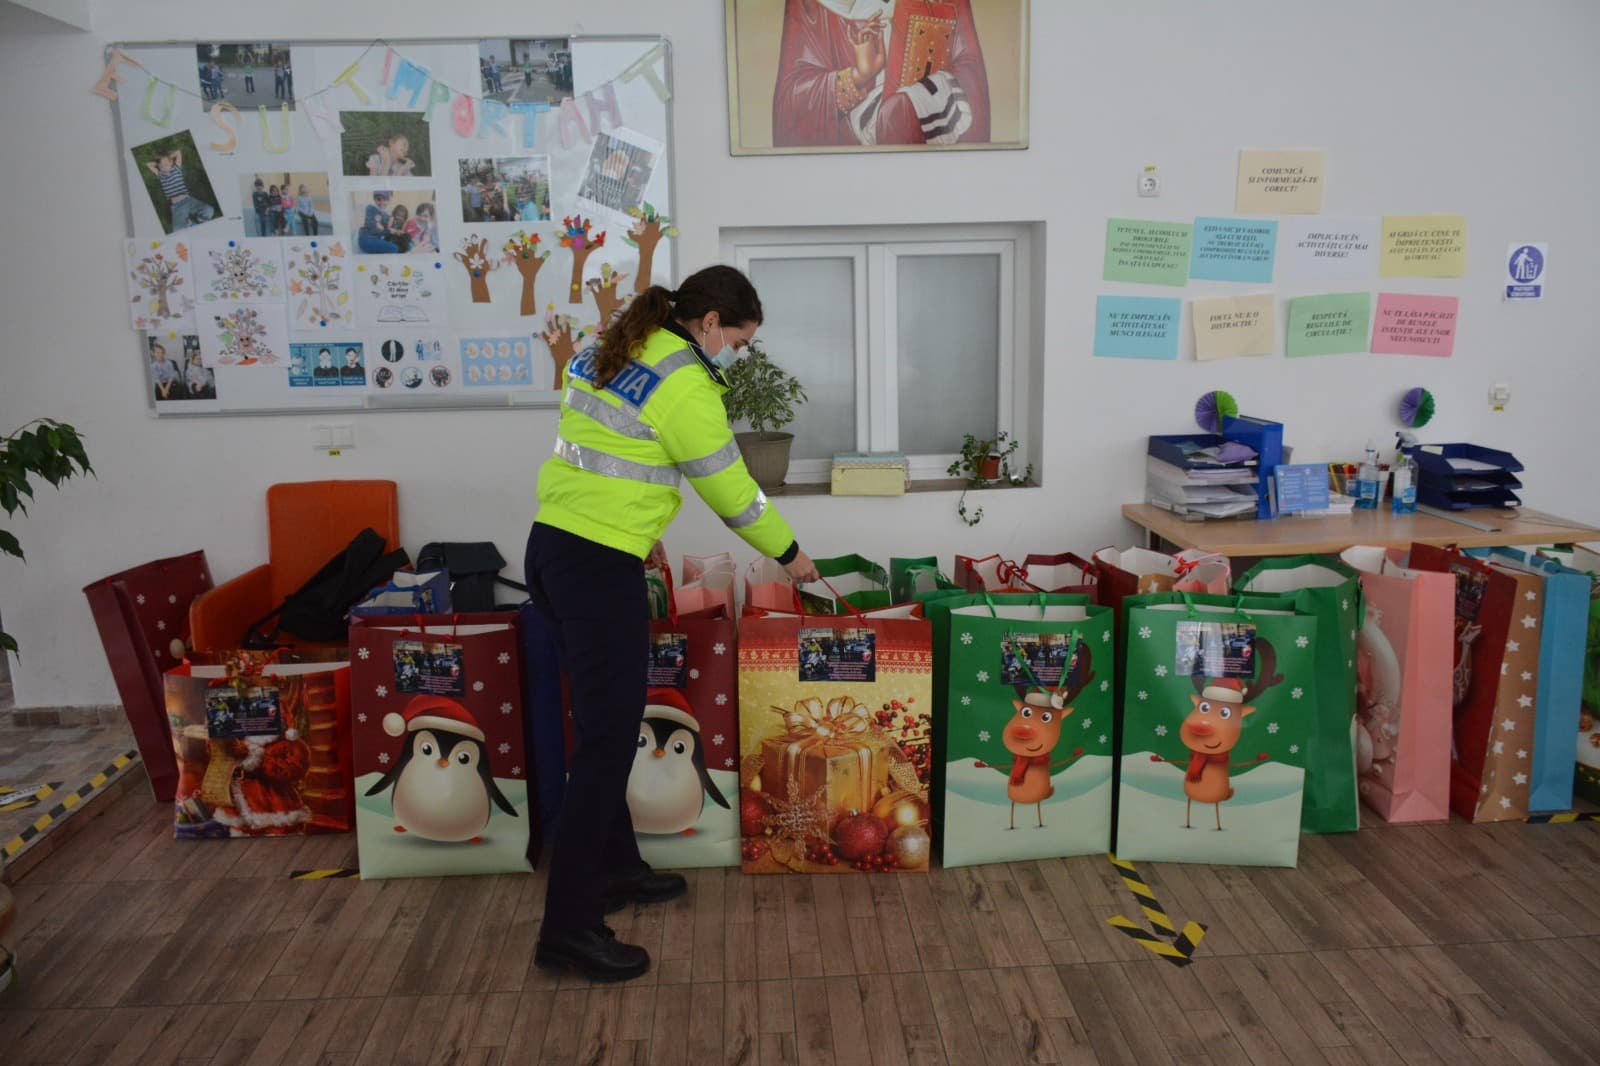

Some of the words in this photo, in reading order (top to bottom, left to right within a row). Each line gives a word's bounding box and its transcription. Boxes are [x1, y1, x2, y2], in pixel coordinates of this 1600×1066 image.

[92, 47, 178, 128] EU
[1210, 313, 1234, 321] FOCUL
[1306, 320, 1341, 328] REGULILE
